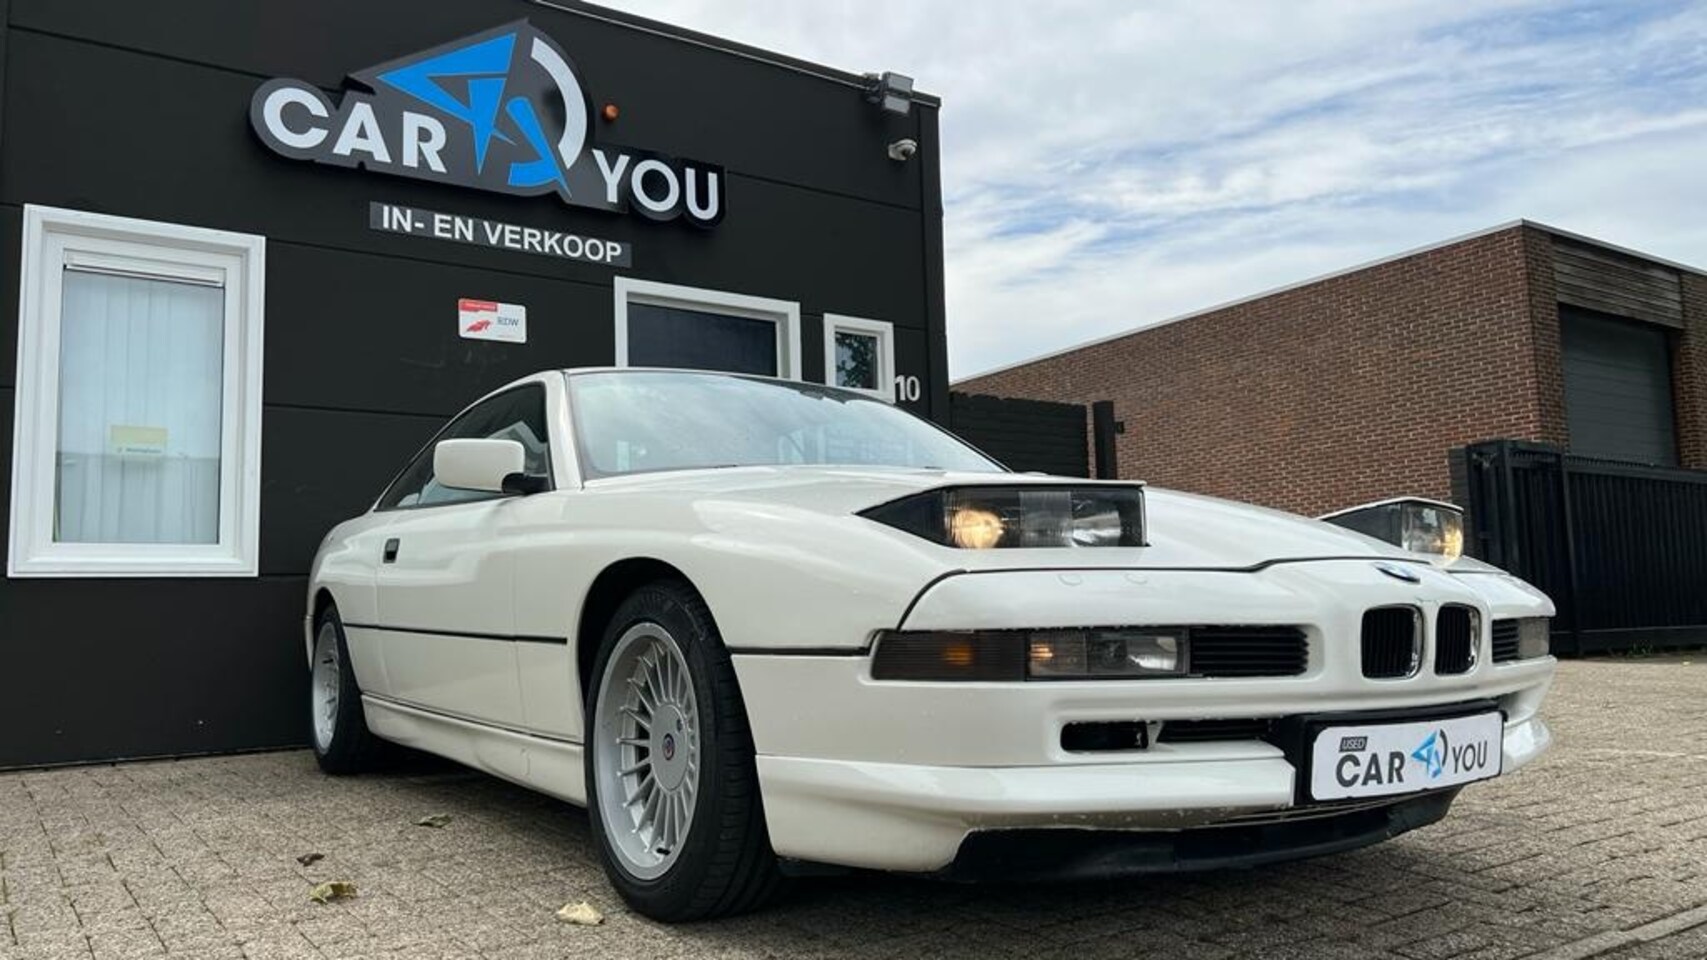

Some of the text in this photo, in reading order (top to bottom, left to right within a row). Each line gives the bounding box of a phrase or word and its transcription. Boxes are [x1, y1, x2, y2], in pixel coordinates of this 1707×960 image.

[263, 87, 447, 174] CAR
[592, 148, 719, 221] YOU
[383, 205, 622, 263] IN- EN VERKOOP
[894, 374, 921, 402] 10
[1335, 751, 1405, 787] CAR
[1452, 740, 1488, 774] YOU
[1341, 738, 1366, 750] USED
